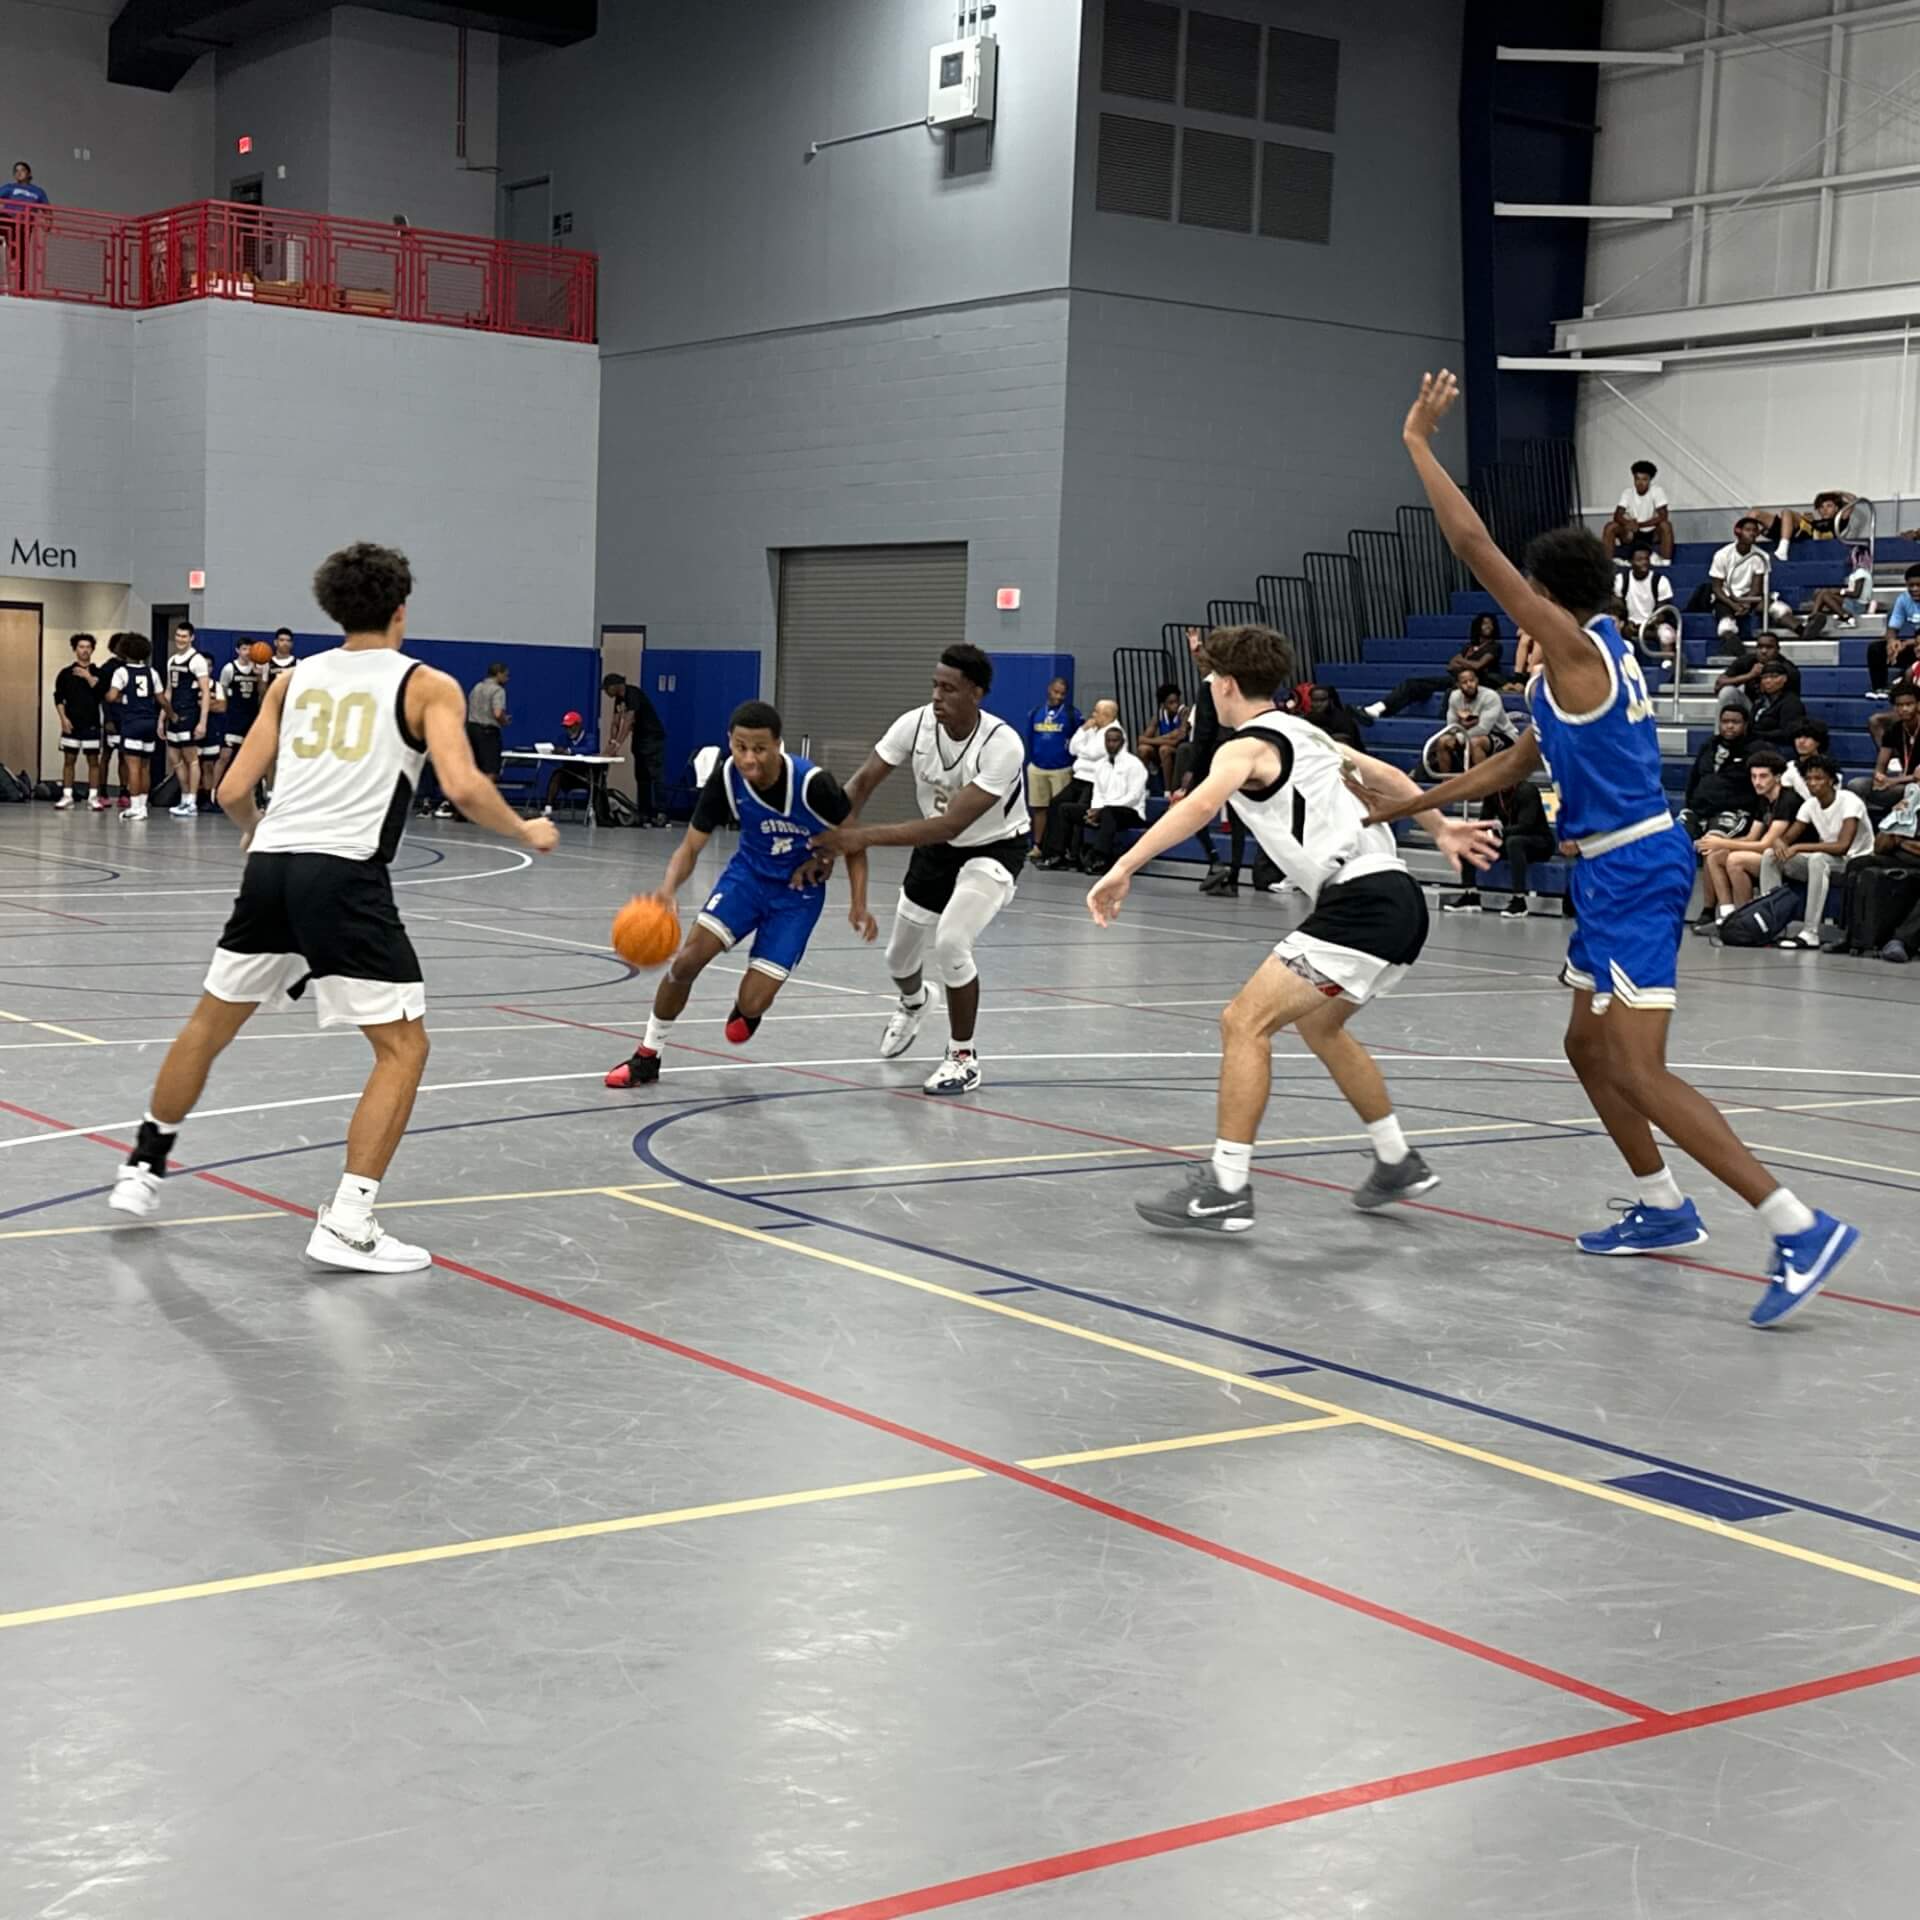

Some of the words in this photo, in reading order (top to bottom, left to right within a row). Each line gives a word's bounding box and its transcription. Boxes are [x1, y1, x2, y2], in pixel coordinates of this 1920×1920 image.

[11, 537, 76, 568] Men
[135, 675, 148, 697] 3
[292, 688, 377, 763] 30
